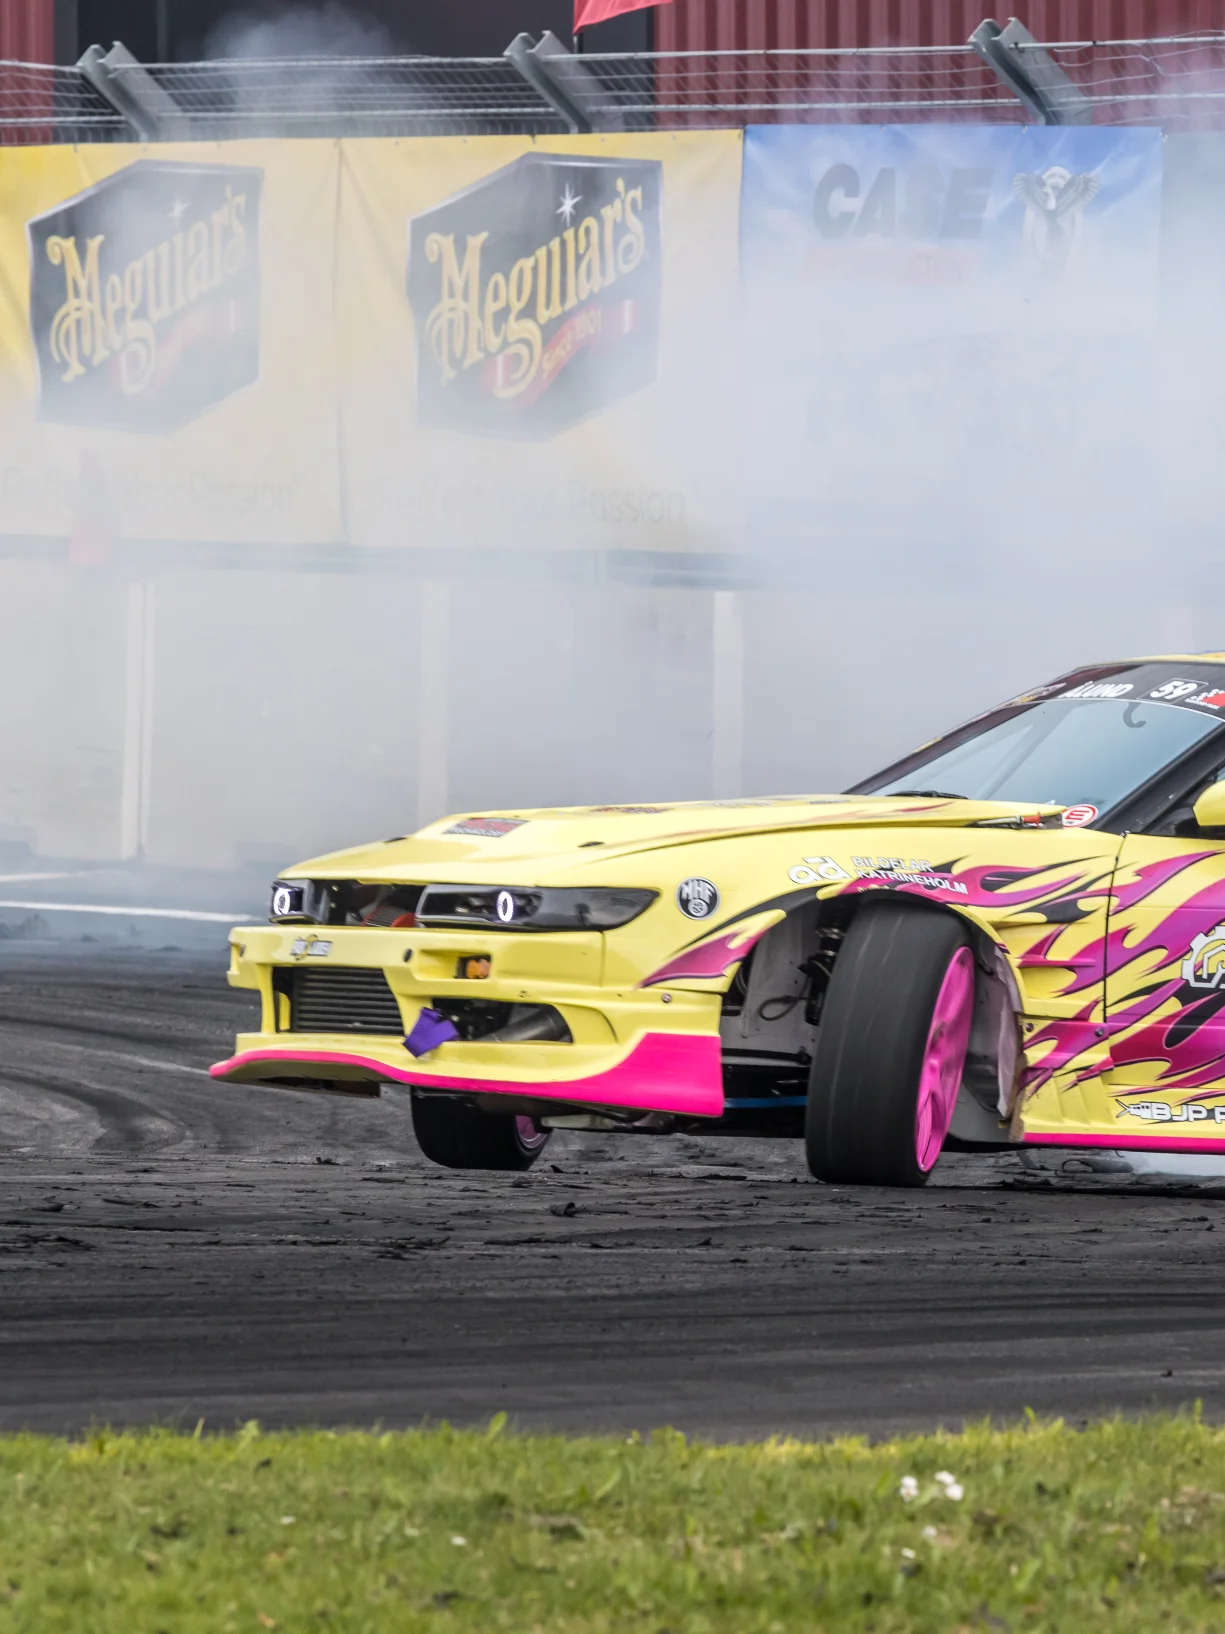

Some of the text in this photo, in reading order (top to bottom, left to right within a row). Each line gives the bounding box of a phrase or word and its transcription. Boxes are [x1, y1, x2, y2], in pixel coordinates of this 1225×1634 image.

[812, 163, 994, 239] CASE
[47, 185, 247, 395] Meguiar's
[425, 178, 645, 399] Meguiar's
[1150, 680, 1198, 700] 59
[851, 856, 935, 874] BILDELAR
[853, 869, 969, 895] KATRINEHOLM
[1151, 1102, 1208, 1123] BJP
